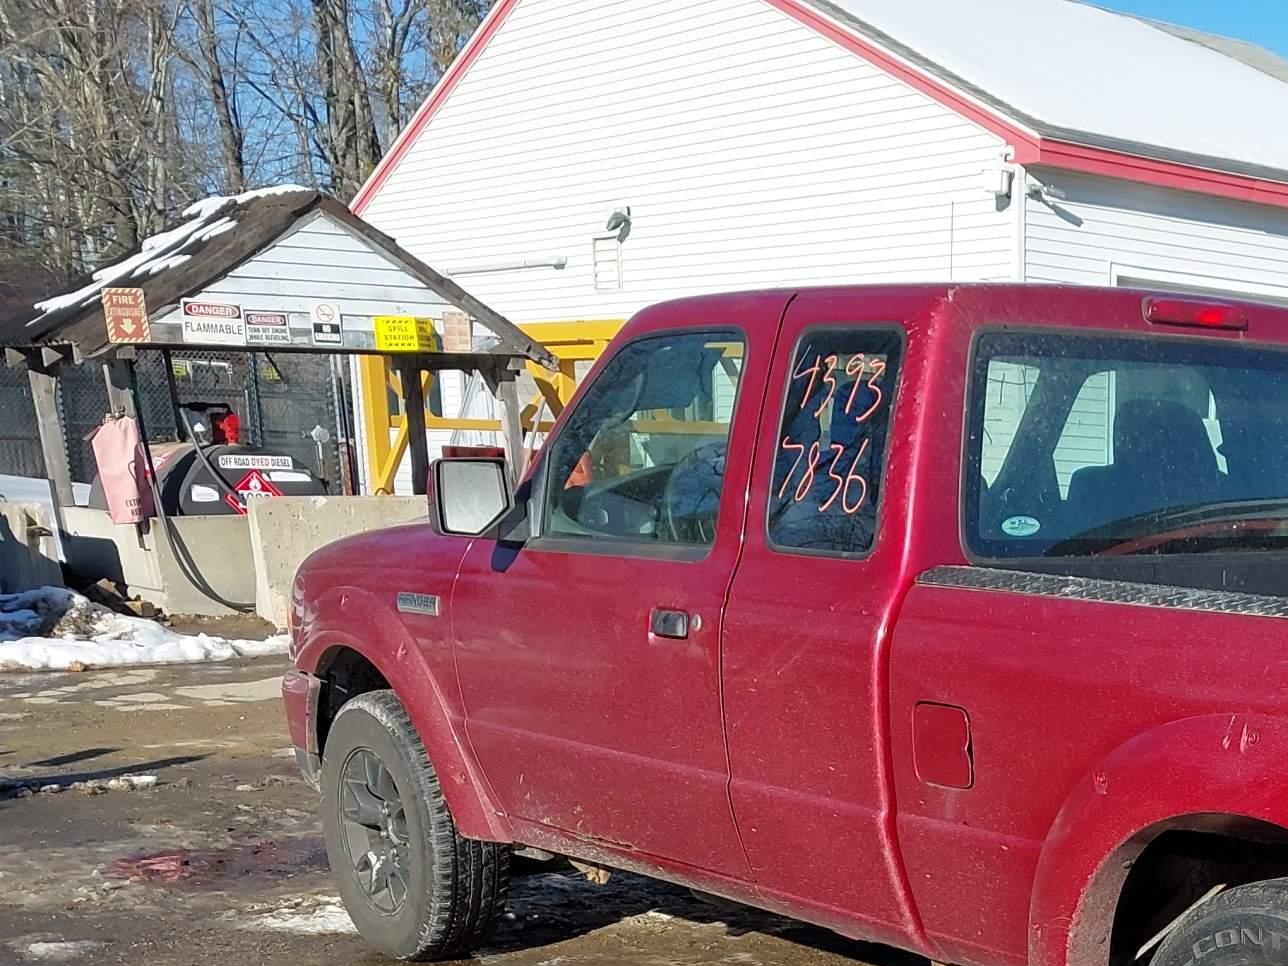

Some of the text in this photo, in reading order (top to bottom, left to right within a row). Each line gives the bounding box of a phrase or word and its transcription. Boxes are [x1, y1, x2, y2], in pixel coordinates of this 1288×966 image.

[112, 295, 135, 305] FIRE
[191, 306, 233, 316] DANGER
[252, 315, 281, 323] DANGER
[184, 321, 243, 335] FLAMMABLE
[322, 324, 331, 333] NO
[792, 343, 886, 422] 4393
[220, 456, 291, 468] OFF ROAD DYED DIESEL
[778, 435, 869, 513] 7836
